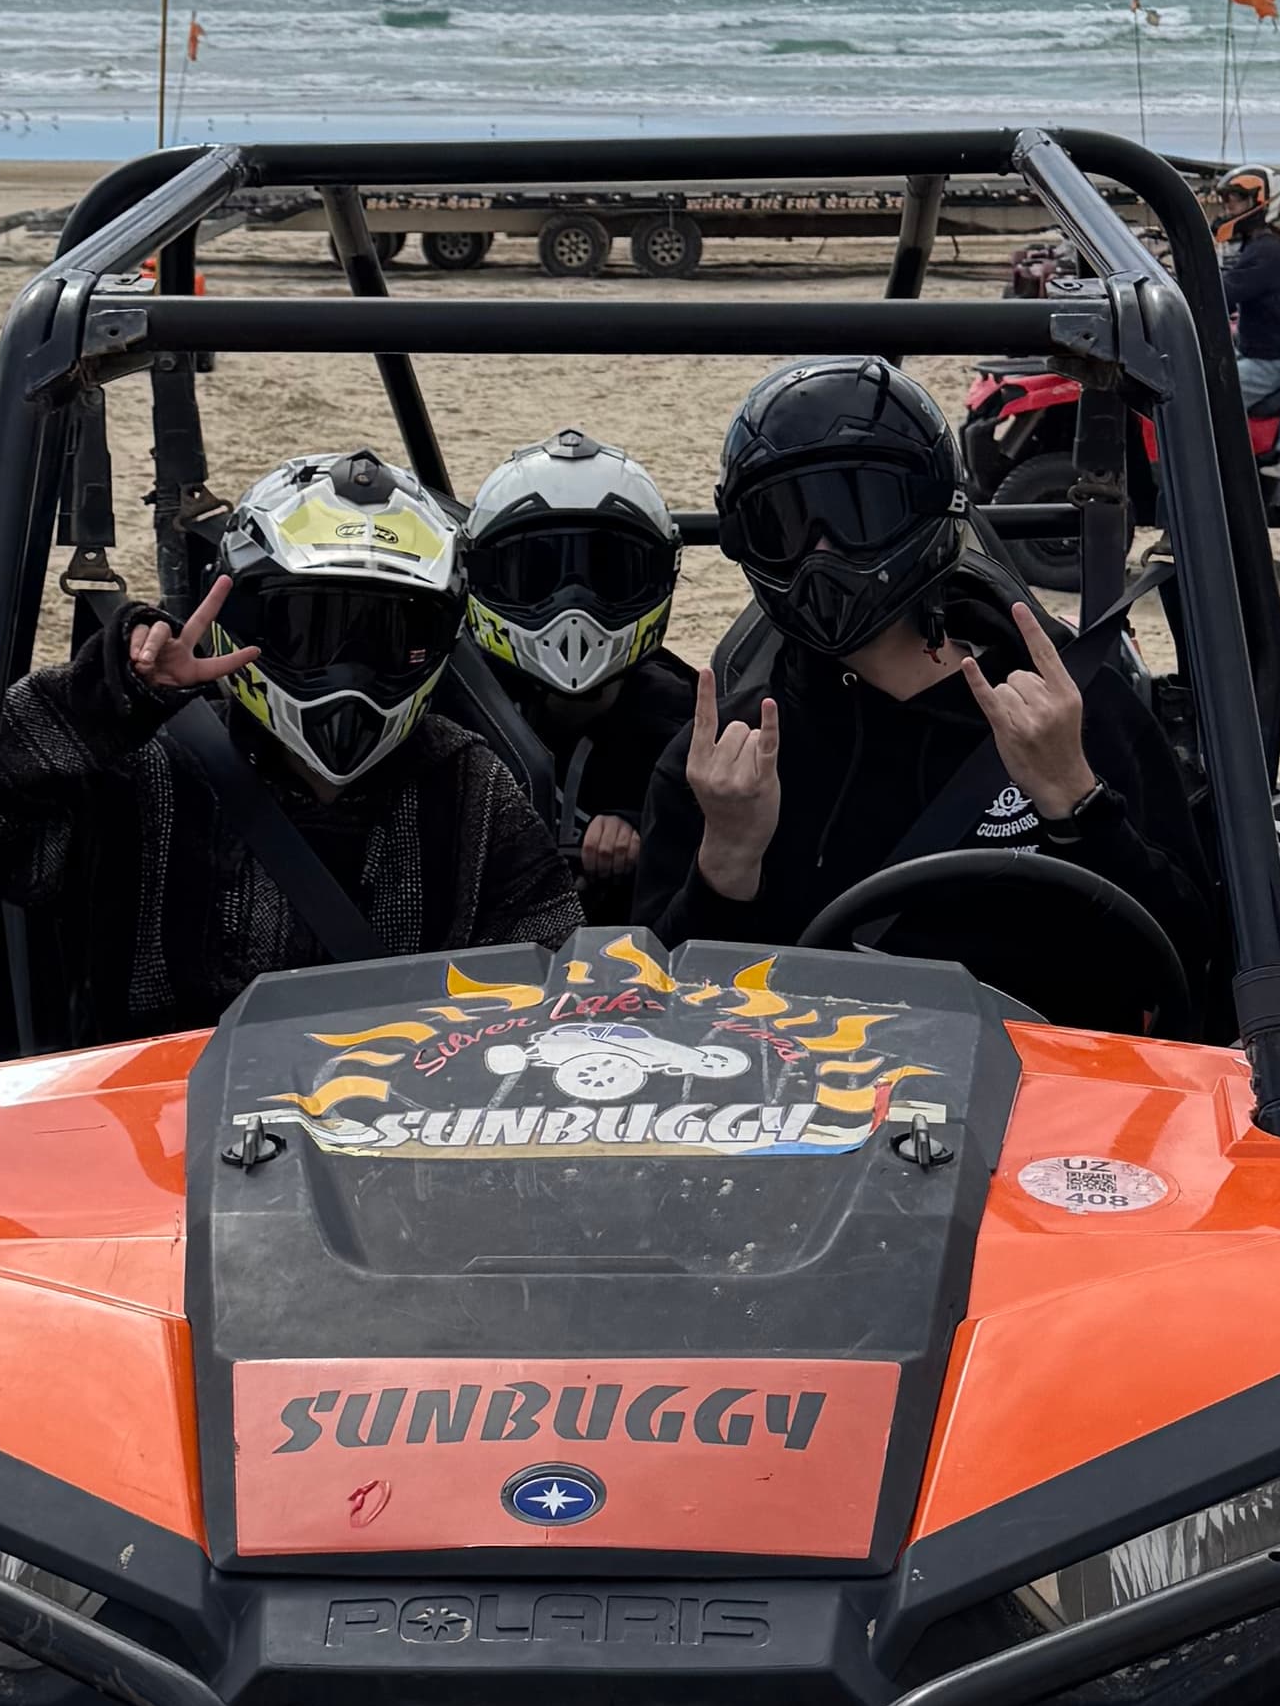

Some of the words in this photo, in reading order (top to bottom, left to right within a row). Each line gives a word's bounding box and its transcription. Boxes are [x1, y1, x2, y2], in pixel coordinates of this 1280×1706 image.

[686, 197, 745, 209] WHERE
[751, 197, 782, 209] THE
[786, 197, 820, 209] FUN
[825, 196, 880, 209] NEVER
[413, 1017, 536, 1077] Silver
[370, 1102, 819, 1147] SUNBUGGY
[1063, 1158, 1112, 1173] UZ
[1065, 1192, 1129, 1207] 408
[272, 1380, 827, 1454] SUNBUGGY
[324, 1593, 771, 1647] POLARIS
